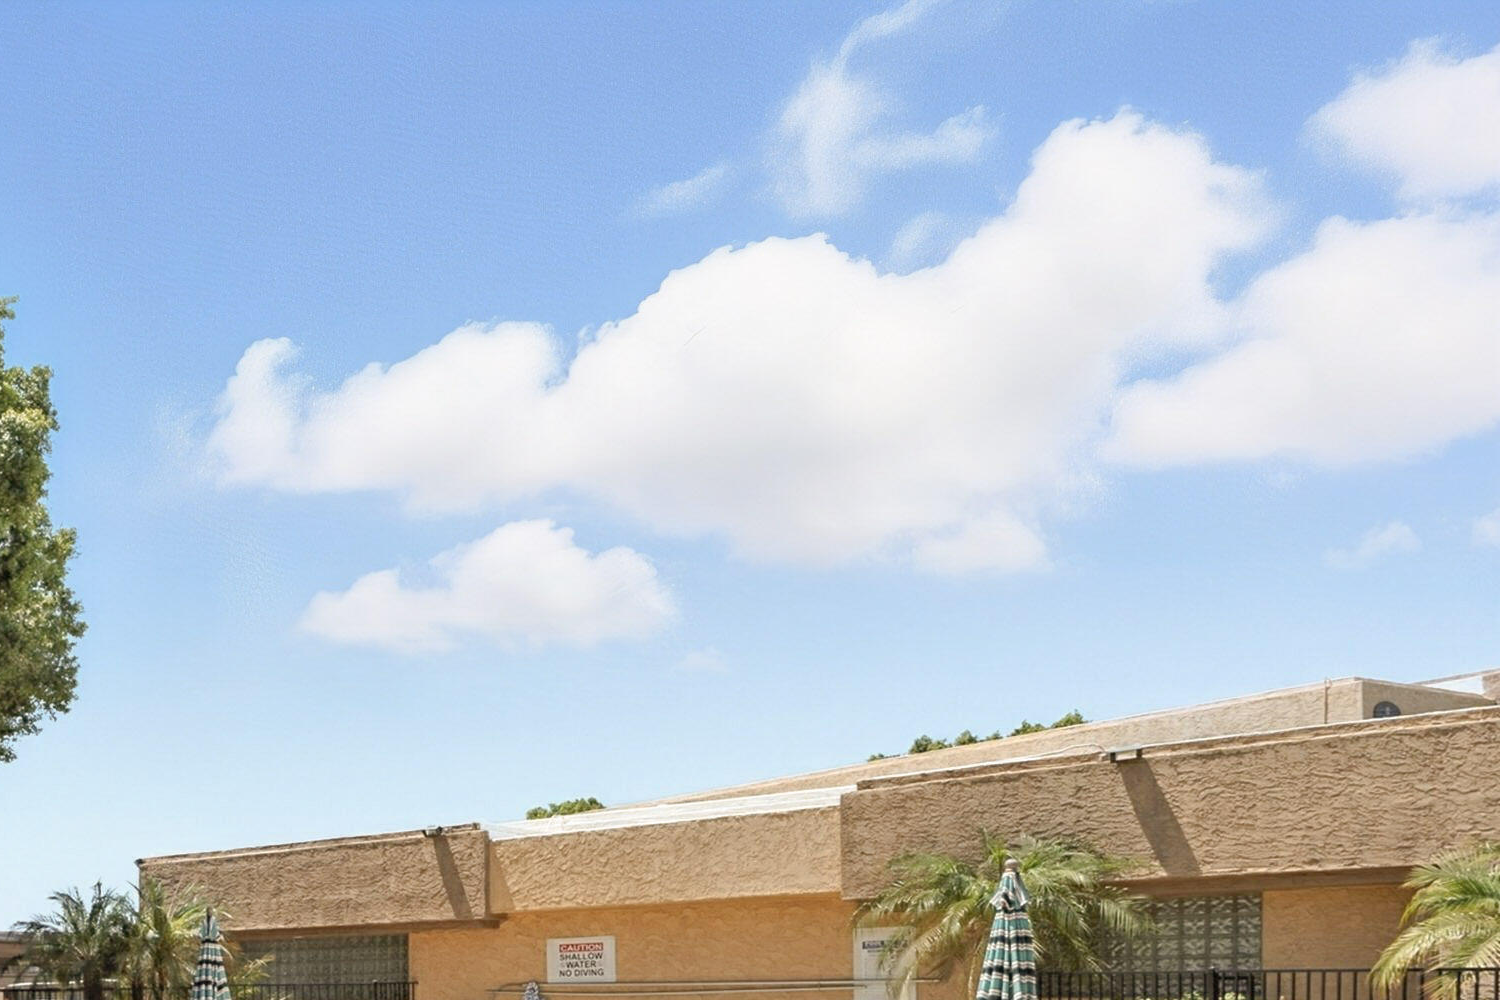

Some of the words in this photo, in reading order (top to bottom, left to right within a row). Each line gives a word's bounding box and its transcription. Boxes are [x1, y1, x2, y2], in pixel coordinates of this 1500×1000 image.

[560, 943, 603, 951] CAUTION
[559, 952, 603, 960] SHALLOW
[566, 960, 596, 968] WATER
[574, 968, 604, 977] DIVING
